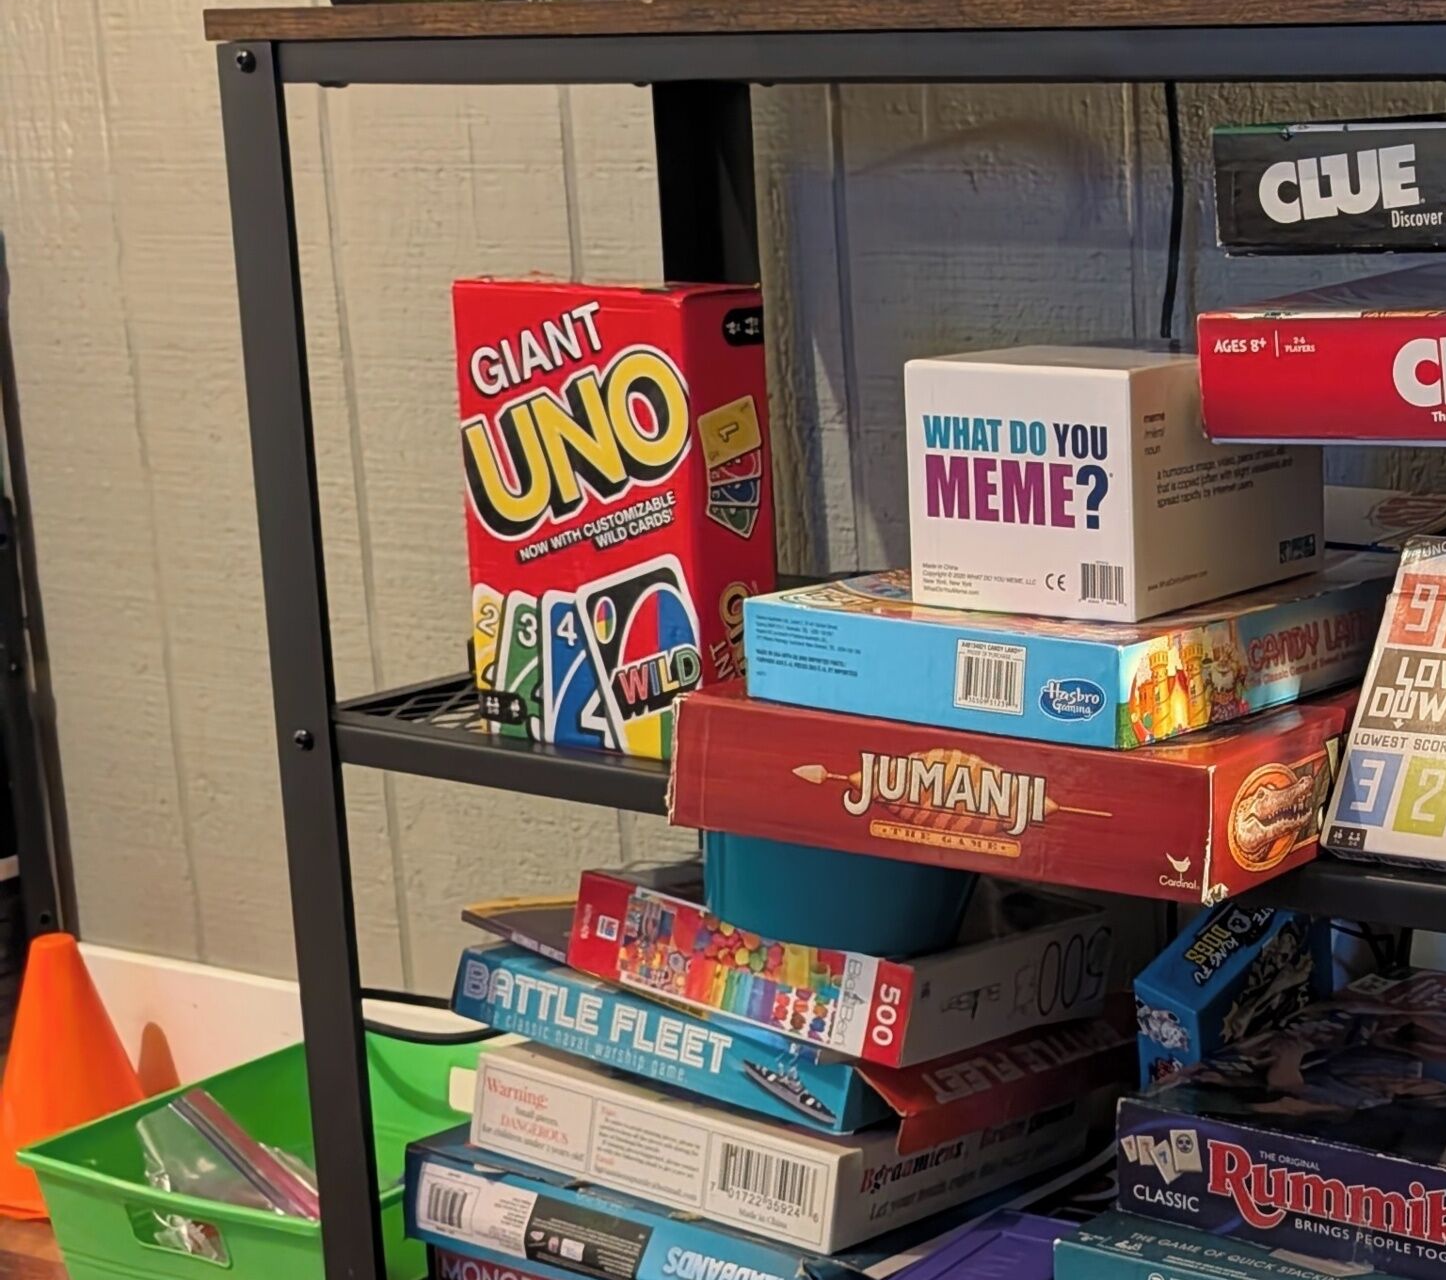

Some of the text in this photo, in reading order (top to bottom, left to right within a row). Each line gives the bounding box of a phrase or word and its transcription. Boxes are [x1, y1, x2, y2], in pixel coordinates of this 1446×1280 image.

[1258, 143, 1420, 224] CLUE
[1391, 206, 1443, 229] Discover
[469, 301, 604, 397] GIANT
[1213, 336, 1268, 354] AGES 8+
[1284, 343, 1316, 354] PLAYERS
[462, 347, 691, 532] UNO
[922, 414, 1109, 461] WHAT DO YOU
[924, 453, 1109, 531] MEME?
[519, 490, 677, 561] NOW WITH CUSTOMIZABLE
[595, 509, 675, 550] WILD CARDS!
[478, 605, 579, 648] 2 3 4
[1403, 583, 1440, 633] 9
[1247, 620, 1320, 673] CANDY
[617, 649, 701, 705] WILD
[1043, 681, 1100, 706] Hasbro
[1052, 698, 1093, 718] Gaming
[1353, 732, 1409, 749] LOWEST
[843, 751, 1047, 836] JUMANJI
[1350, 758, 1442, 823] 3 2
[887, 823, 1000, 852] THE GAME
[1158, 874, 1198, 891] Cardinal
[1184, 923, 1232, 965] DOGS
[462, 959, 733, 1075] BATTLE FLEET
[870, 983, 901, 1047] 500
[504, 1012, 689, 1084] classic naval warship game.
[485, 1076, 549, 1110] Warning:
[500, 1113, 569, 1145] DANGEROUS
[1259, 1149, 1321, 1172] THE ORIGINAL
[727, 1186, 762, 1208] 01722
[738, 1207, 757, 1220] Made
[1133, 1184, 1200, 1213] CLASSIC
[1130, 1232, 1157, 1243] THE
[1158, 1238, 1202, 1254] GAME
[1203, 1248, 1227, 1259] OF
[1227, 1254, 1278, 1271] QUICK
[1294, 1218, 1351, 1241] BRINGS
[1355, 1232, 1412, 1255] PEOPLE
